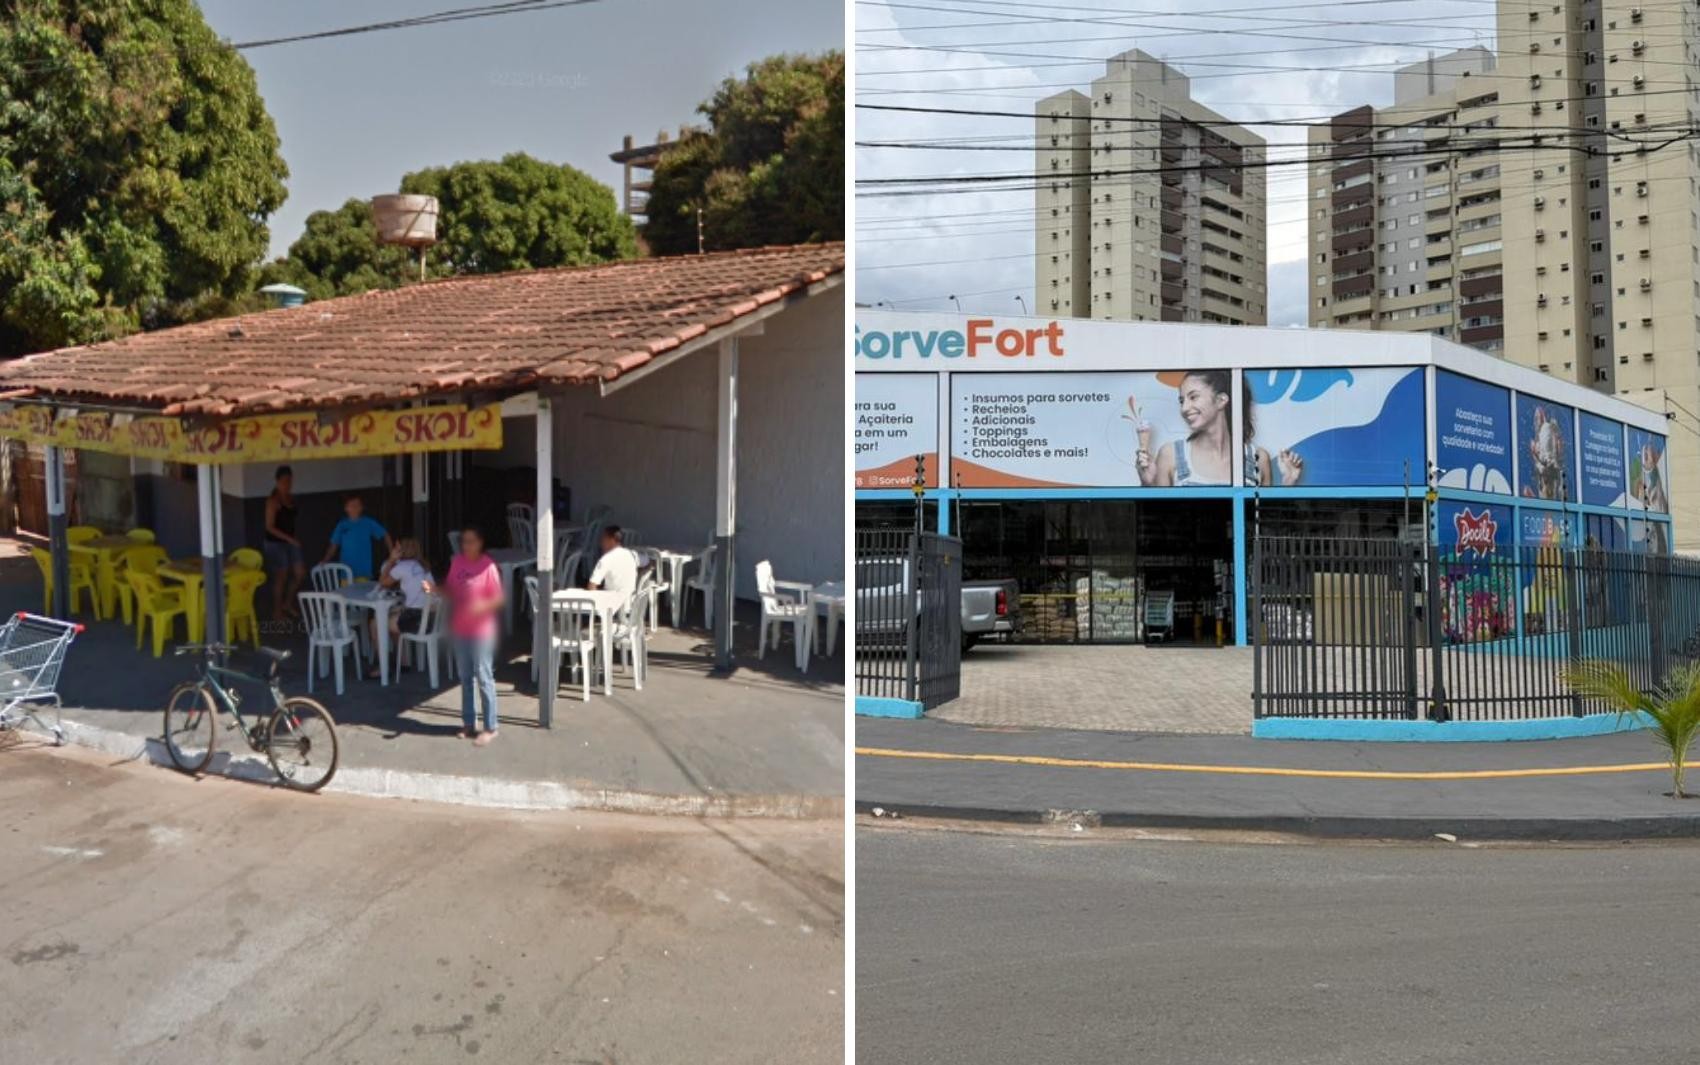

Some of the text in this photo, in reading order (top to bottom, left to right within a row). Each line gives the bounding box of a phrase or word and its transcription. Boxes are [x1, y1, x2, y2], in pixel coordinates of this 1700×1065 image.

[855, 319, 1064, 359] orveFort
[972, 393, 1110, 405] Insumos para sorvetes
[874, 402, 896, 411] sua
[972, 404, 1027, 414] Recheios
[972, 415, 1036, 425] Adicionais
[186, 411, 474, 455] KOL SKOL SKOL
[864, 429, 884, 438] em
[887, 429, 908, 438] um
[972, 426, 1028, 438] Toppings
[972, 437, 1048, 449] Embalagens
[972, 447, 1088, 458] Chocolates e mais!
[1461, 519, 1491, 545] Docile
